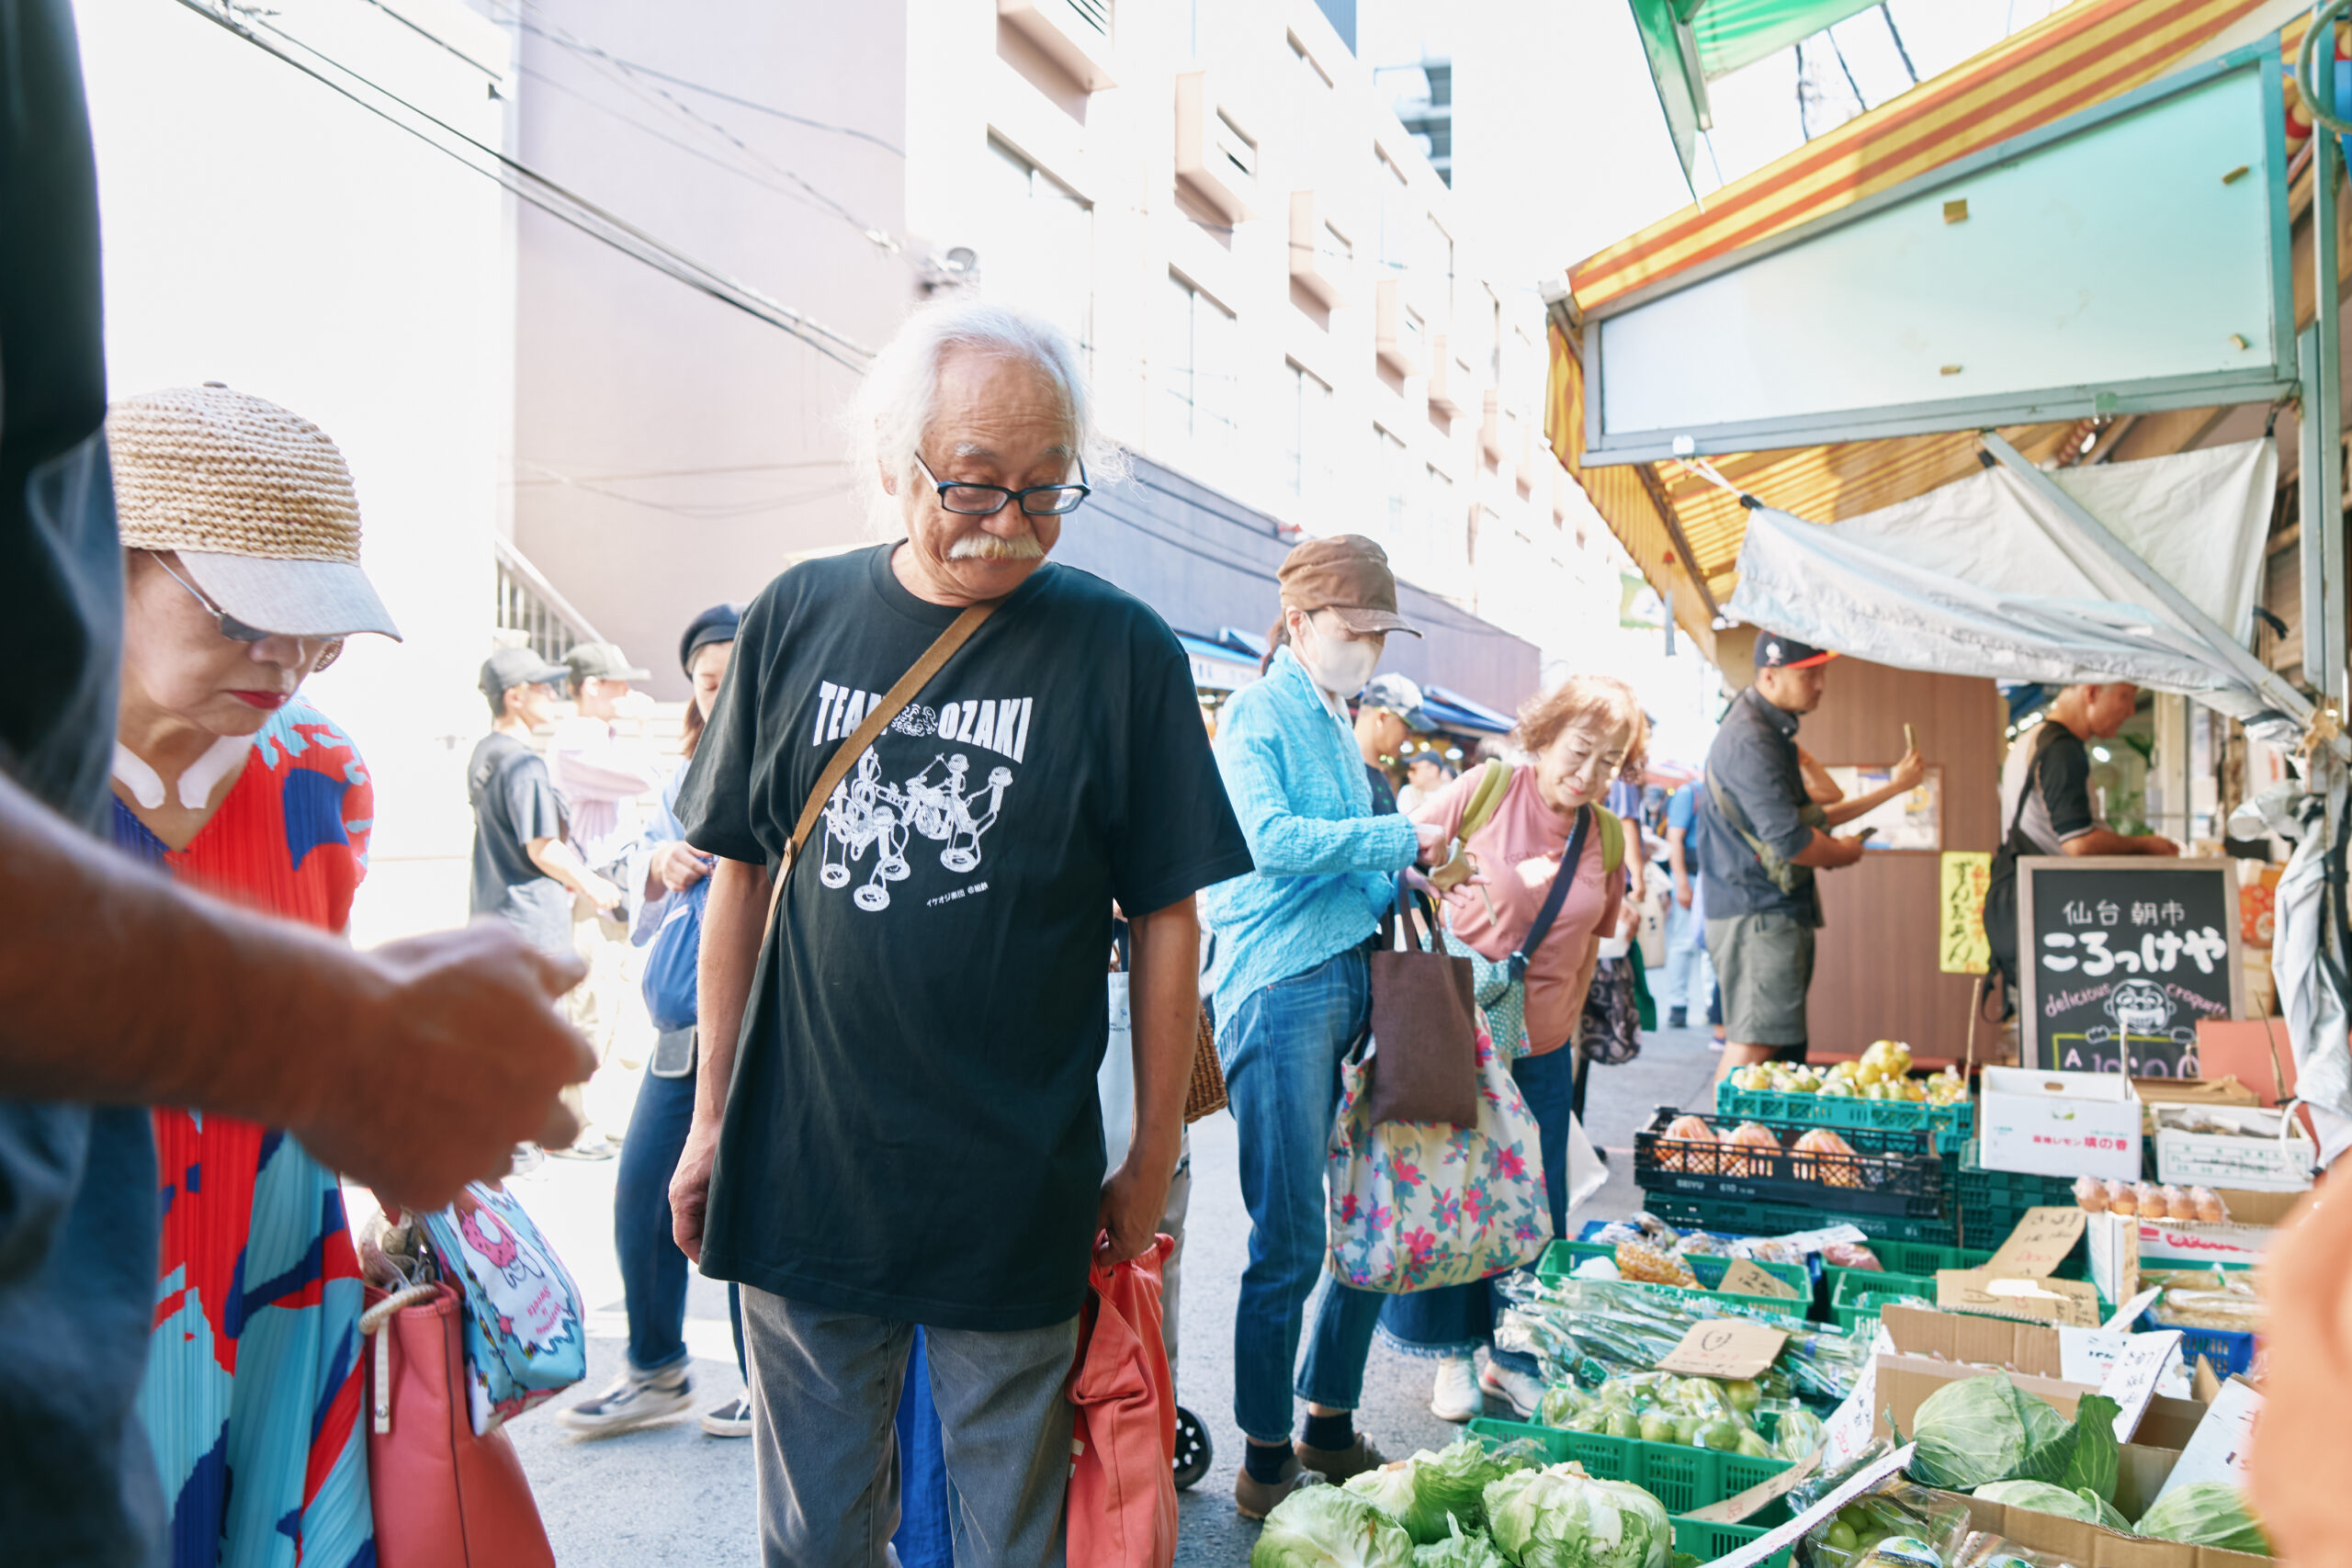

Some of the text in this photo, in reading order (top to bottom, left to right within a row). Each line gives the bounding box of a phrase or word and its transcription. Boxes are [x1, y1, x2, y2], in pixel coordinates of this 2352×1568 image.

[937, 696, 1033, 764] OZAKI
[2063, 899, 2186, 927] 仙台 朝市
[2042, 926, 2227, 976] ころっけや
[2045, 982, 2111, 1018] delicious
